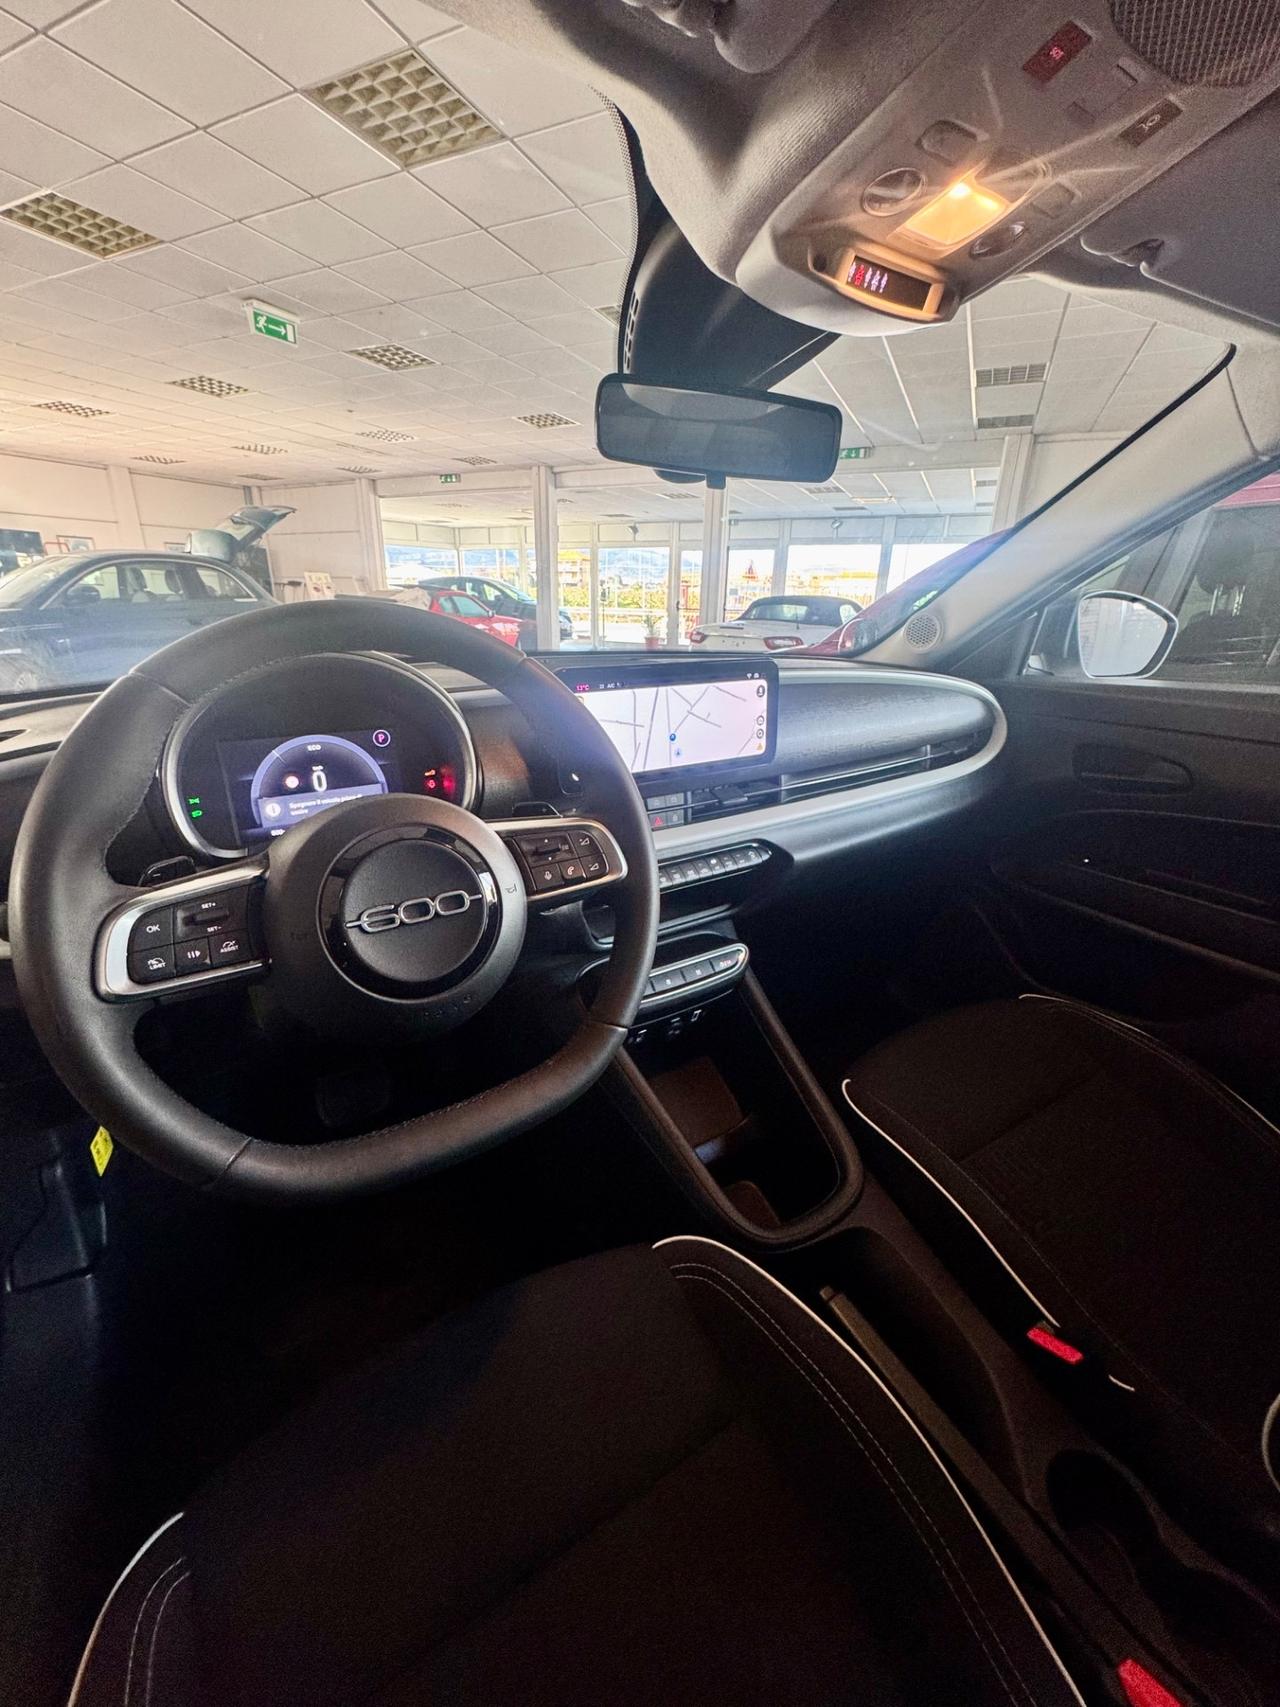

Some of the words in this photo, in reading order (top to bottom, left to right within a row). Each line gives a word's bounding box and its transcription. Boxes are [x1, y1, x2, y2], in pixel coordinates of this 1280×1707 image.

[378, 734, 385, 743] P
[312, 770, 327, 792] 0
[354, 890, 474, 933] 600
[146, 924, 161, 933] OK
[220, 945, 239, 953] ASSIST
[150, 962, 166, 970] LIMIT
